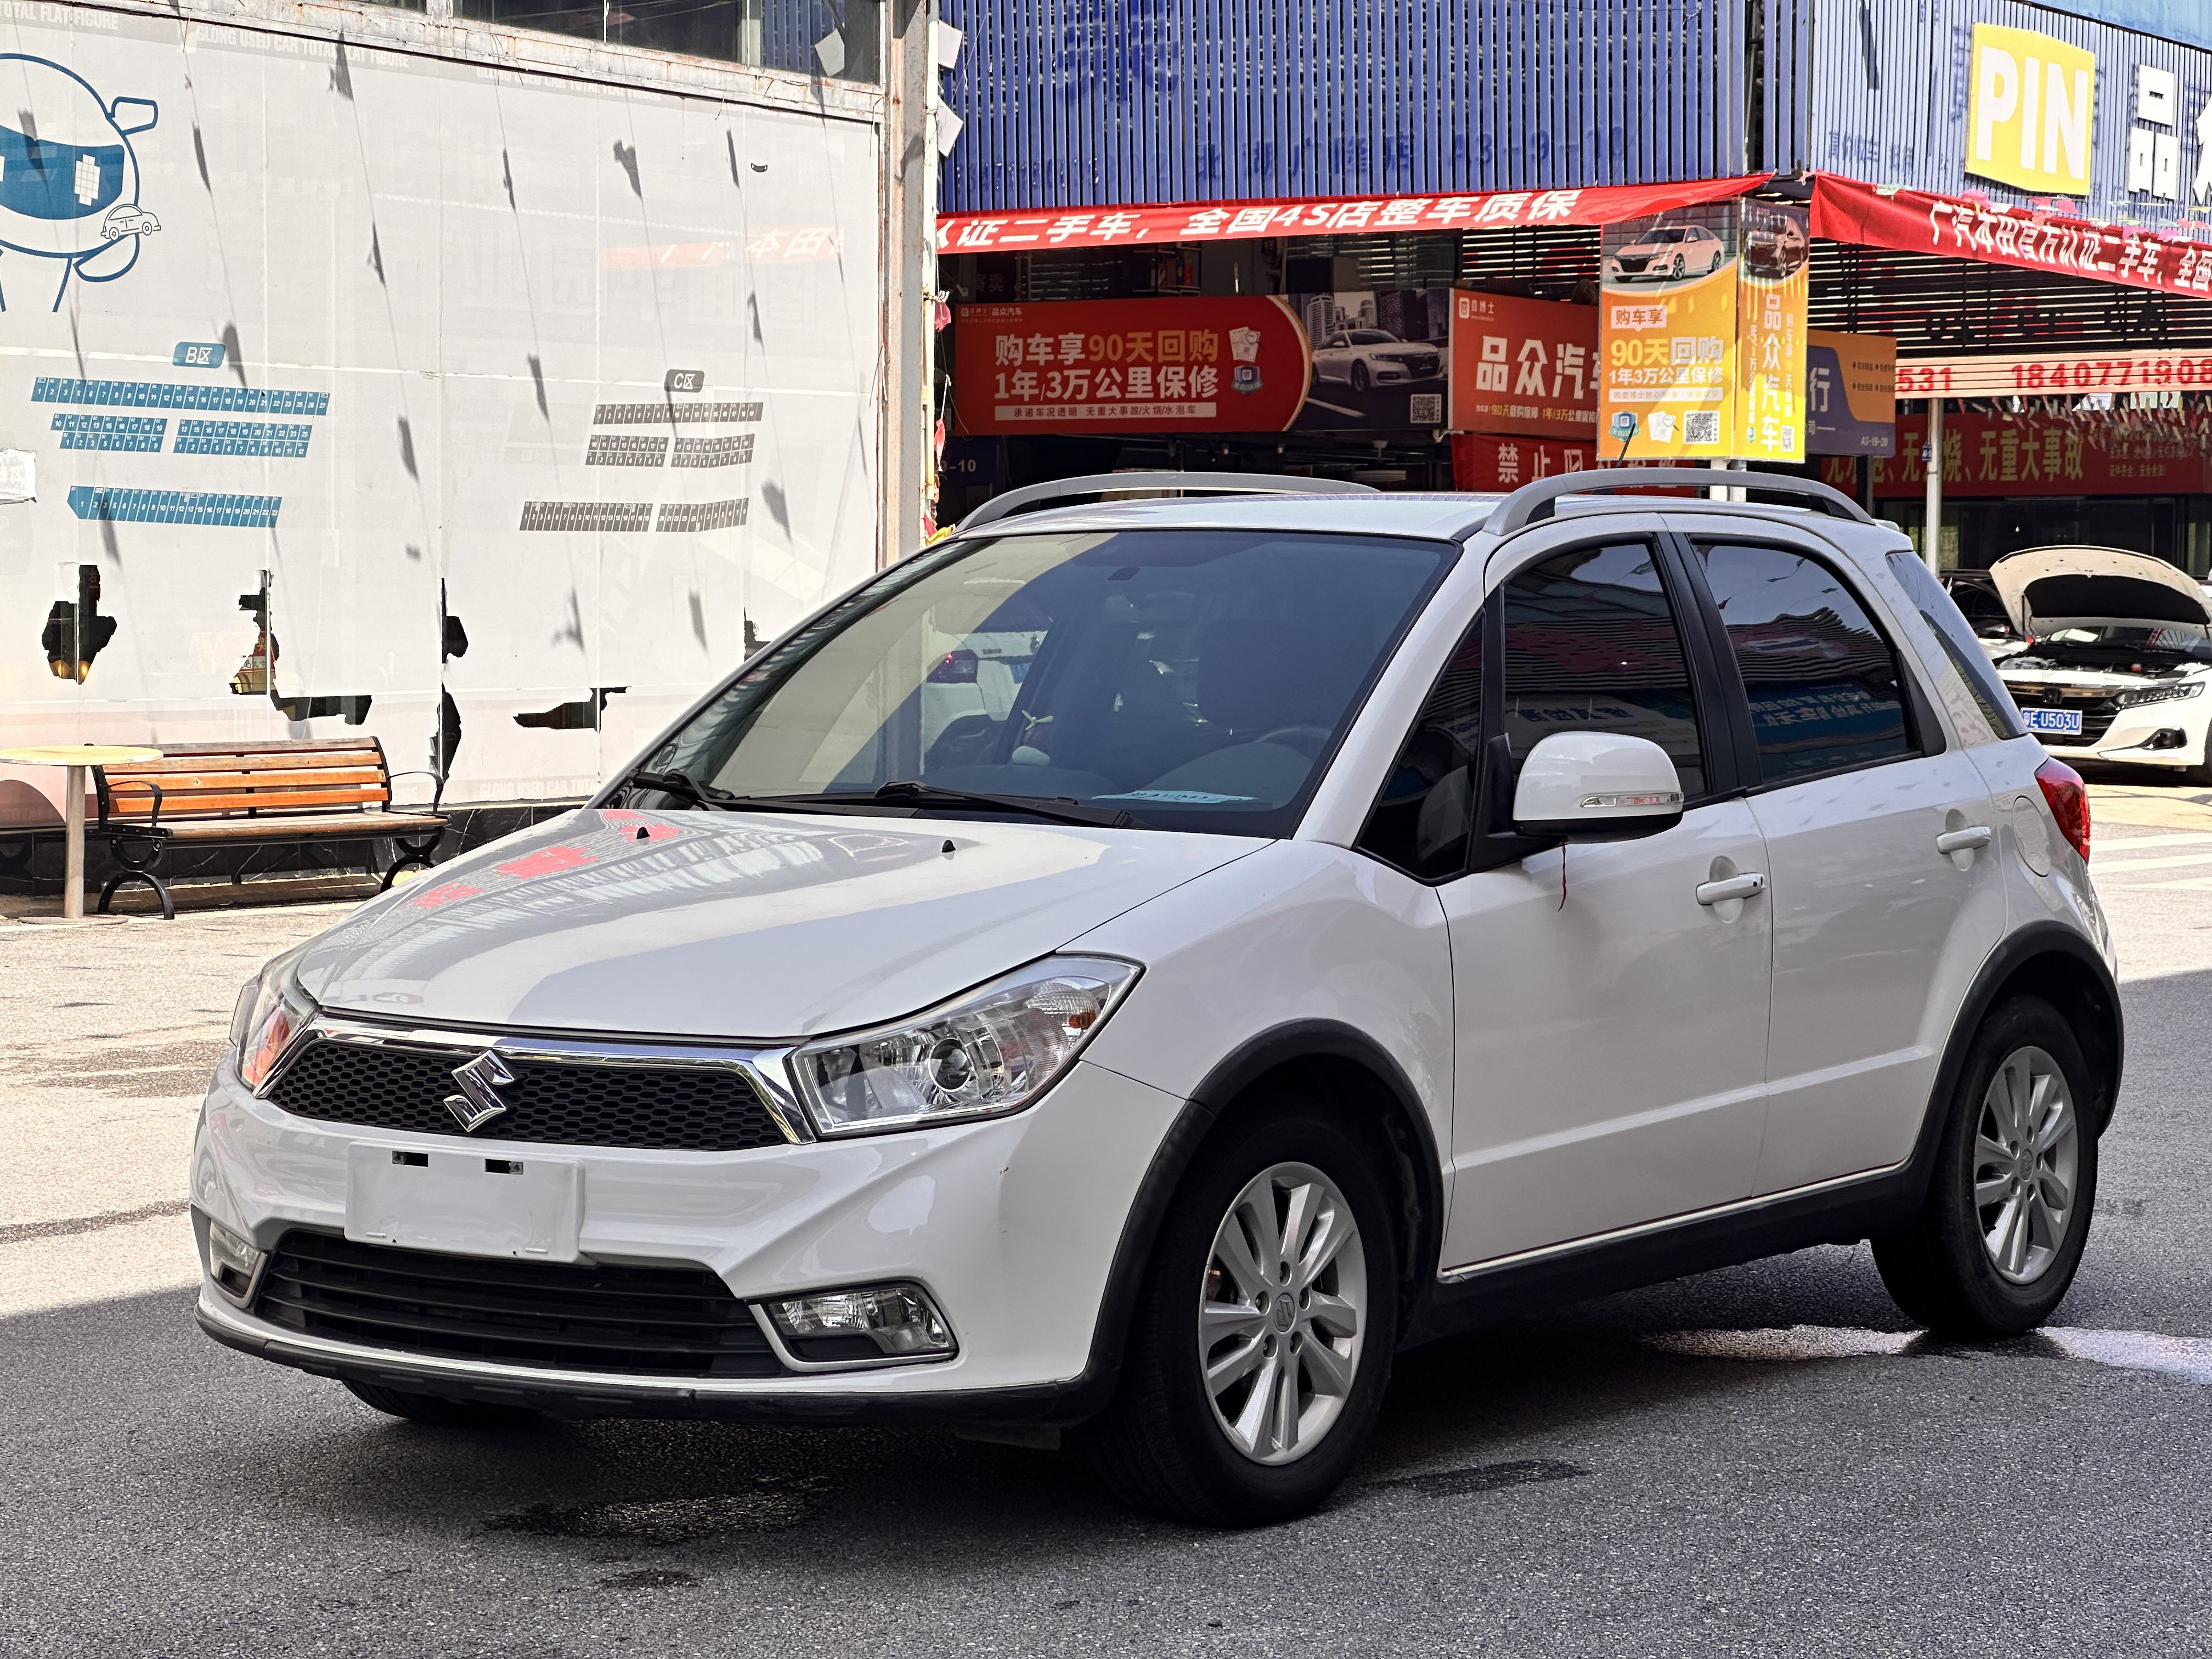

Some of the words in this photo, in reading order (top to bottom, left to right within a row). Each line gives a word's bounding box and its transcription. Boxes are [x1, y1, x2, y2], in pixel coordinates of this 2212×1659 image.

[74, 11, 119, 30] FIGURE
[240, 29, 269, 49] USED
[274, 36, 298, 53] CAR
[1976, 45, 2090, 179] PIN
[992, 307, 1023, 316] 品众汽车
[1616, 308, 1662, 325] 购车享
[185, 346, 213, 364] B区
[995, 329, 1219, 366] 购车享90天回购
[1611, 336, 1724, 366] 90天回购
[674, 373, 696, 389] C区
[1609, 366, 1724, 385] 1年/3万公里保修
[1760, 294, 1782, 453] 品众汽车
[995, 365, 1219, 402] 1年/3万公里保修
[1809, 367, 1830, 412] 行
[1014, 406, 1077, 417] 承诺车况透明
[1086, 404, 1197, 417] 无重大事故/火烧/水泡车
[1860, 436, 1889, 447] A3-19-20
[517, 780, 546, 797] USED
[547, 779, 568, 795] CAR
